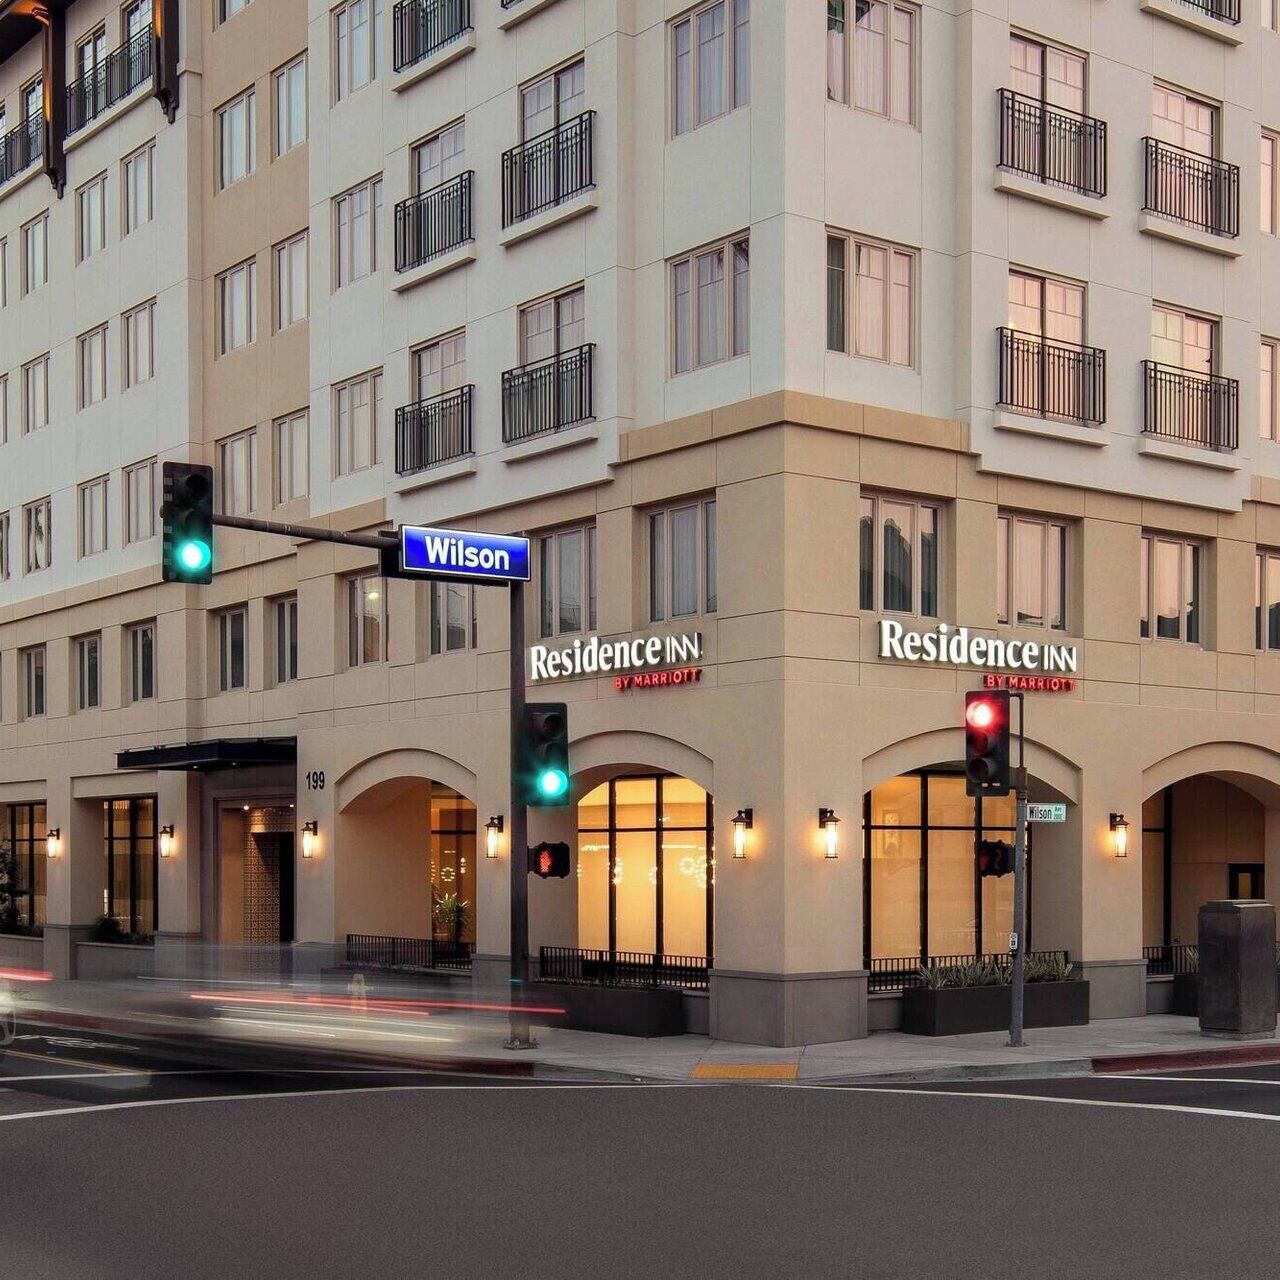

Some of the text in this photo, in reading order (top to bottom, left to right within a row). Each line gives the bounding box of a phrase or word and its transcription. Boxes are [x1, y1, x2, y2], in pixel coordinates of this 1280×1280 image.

[424, 535, 510, 571] Wilson
[531, 632, 700, 680] Residence INN
[880, 620, 1077, 672] Residence INN
[615, 669, 699, 689] BY MARRIOTT
[986, 674, 1075, 691] BY MARRIOTT
[306, 771, 325, 790] 199
[1029, 806, 1052, 820] Wilson
